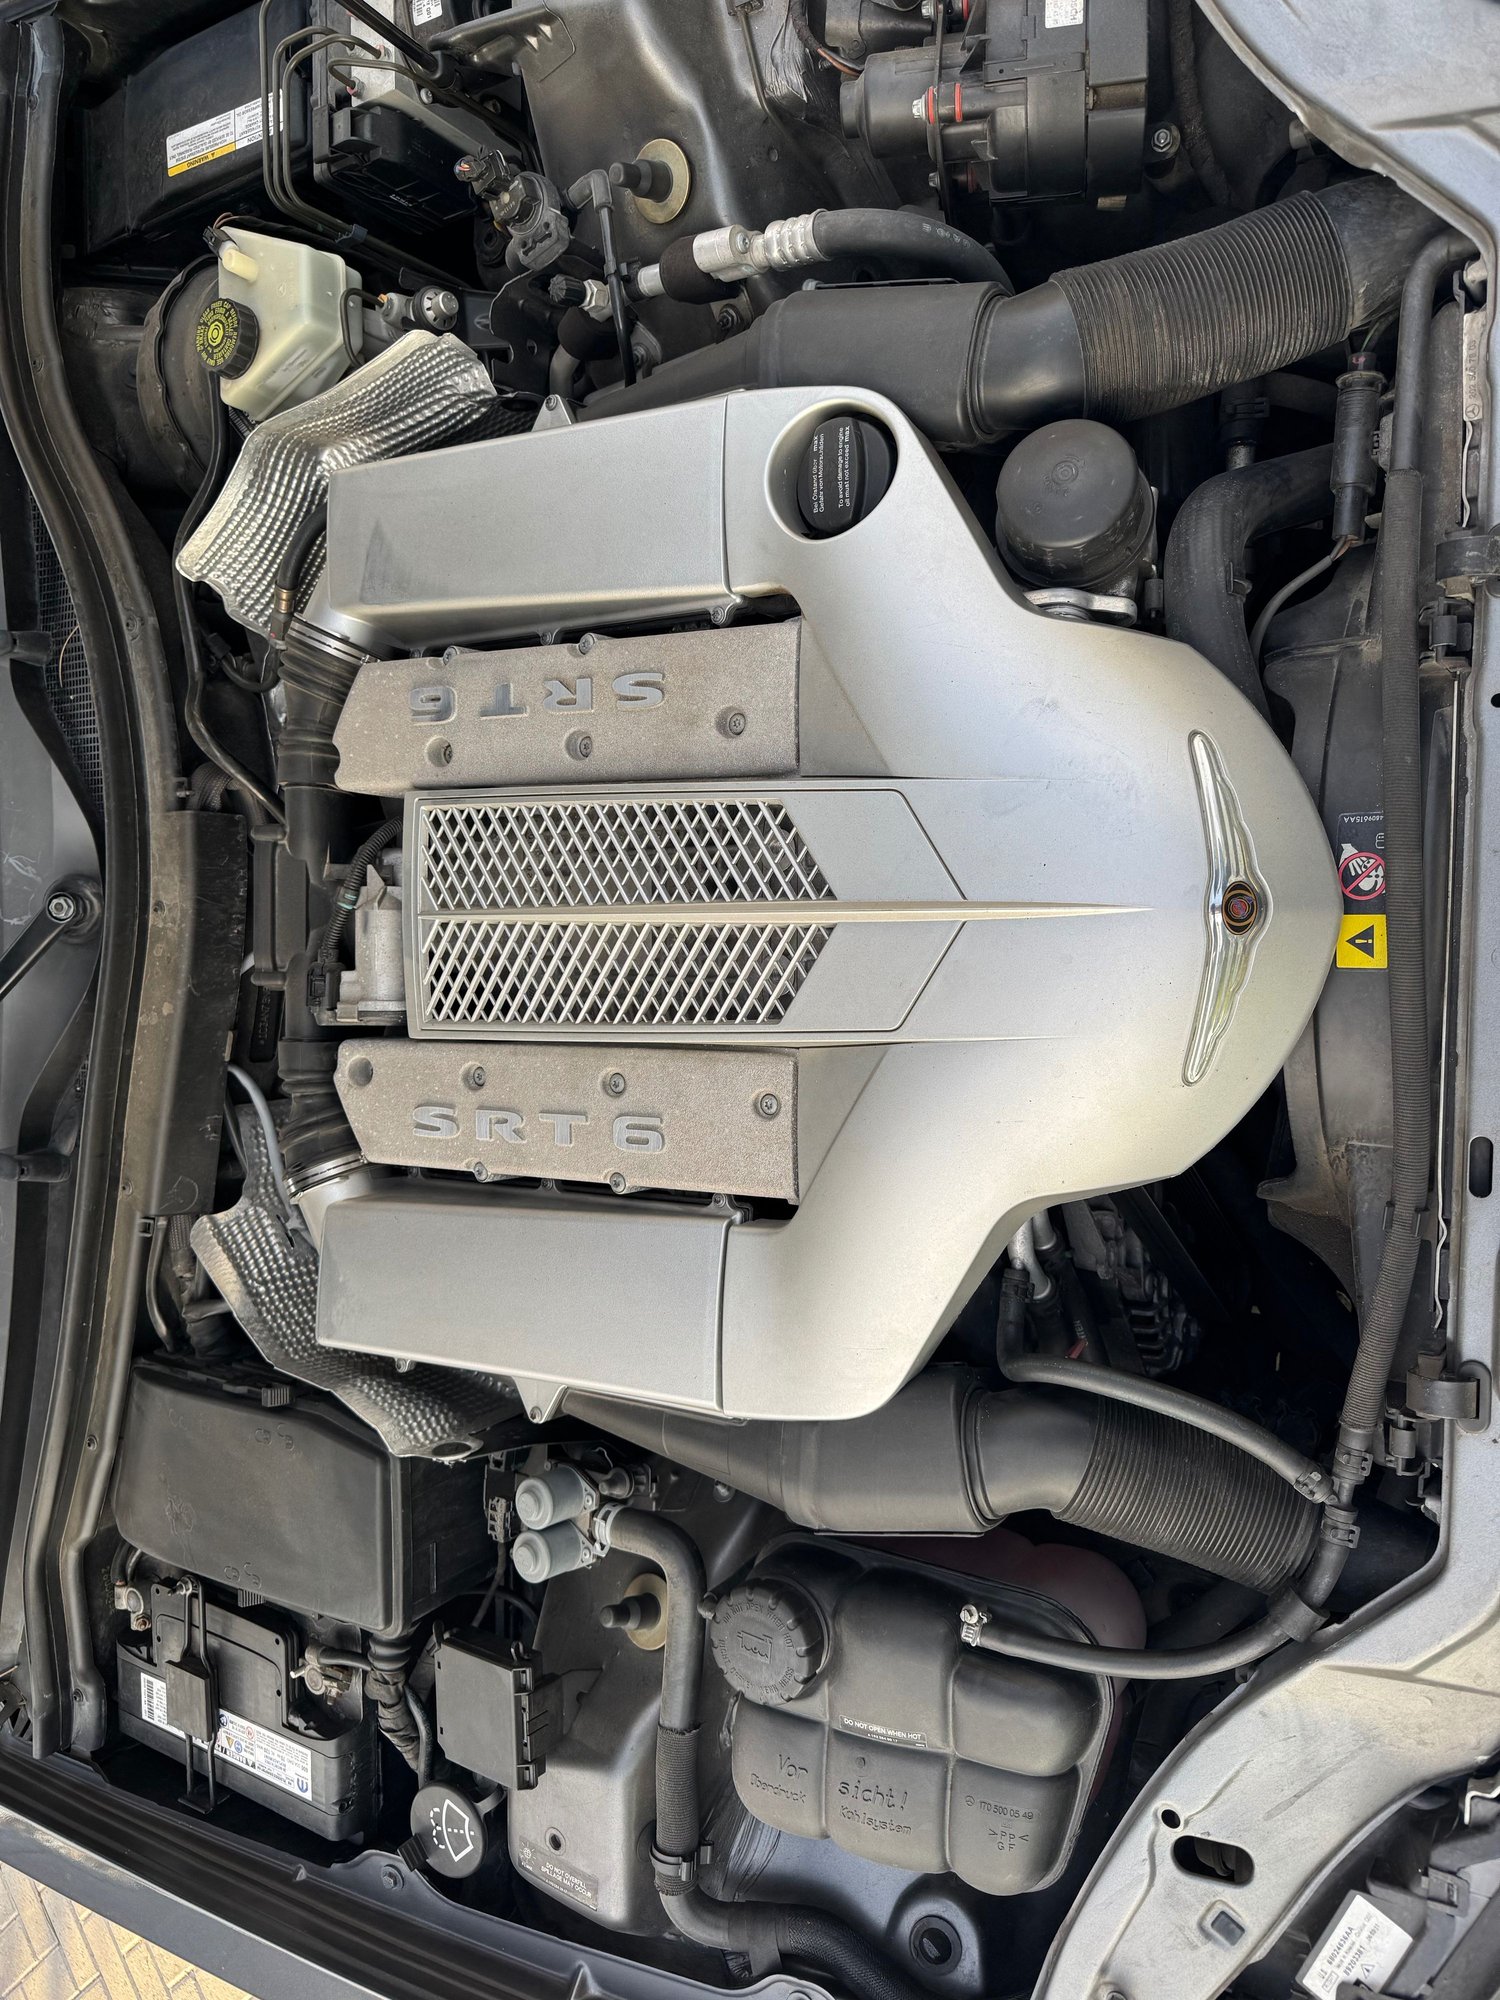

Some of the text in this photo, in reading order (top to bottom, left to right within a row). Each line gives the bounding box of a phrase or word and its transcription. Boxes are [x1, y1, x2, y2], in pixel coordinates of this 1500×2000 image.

[187, 154, 208, 168] WARNING
[413, 1105, 666, 1153] SRT6
[782, 1632, 795, 1649] HOT
[843, 1717, 854, 1726] DO
[854, 1721, 868, 1730] NOT
[868, 1725, 886, 1735] OPEN
[886, 1728, 907, 1739] WHEN
[778, 1754, 808, 1778] Vor
[839, 1780, 908, 1811] sicht!
[993, 1804, 1008, 1816] 500
[1009, 1808, 1020, 1818] 05
[1021, 1811, 1034, 1820] 49
[565, 1872, 587, 1889] OVERFILL
